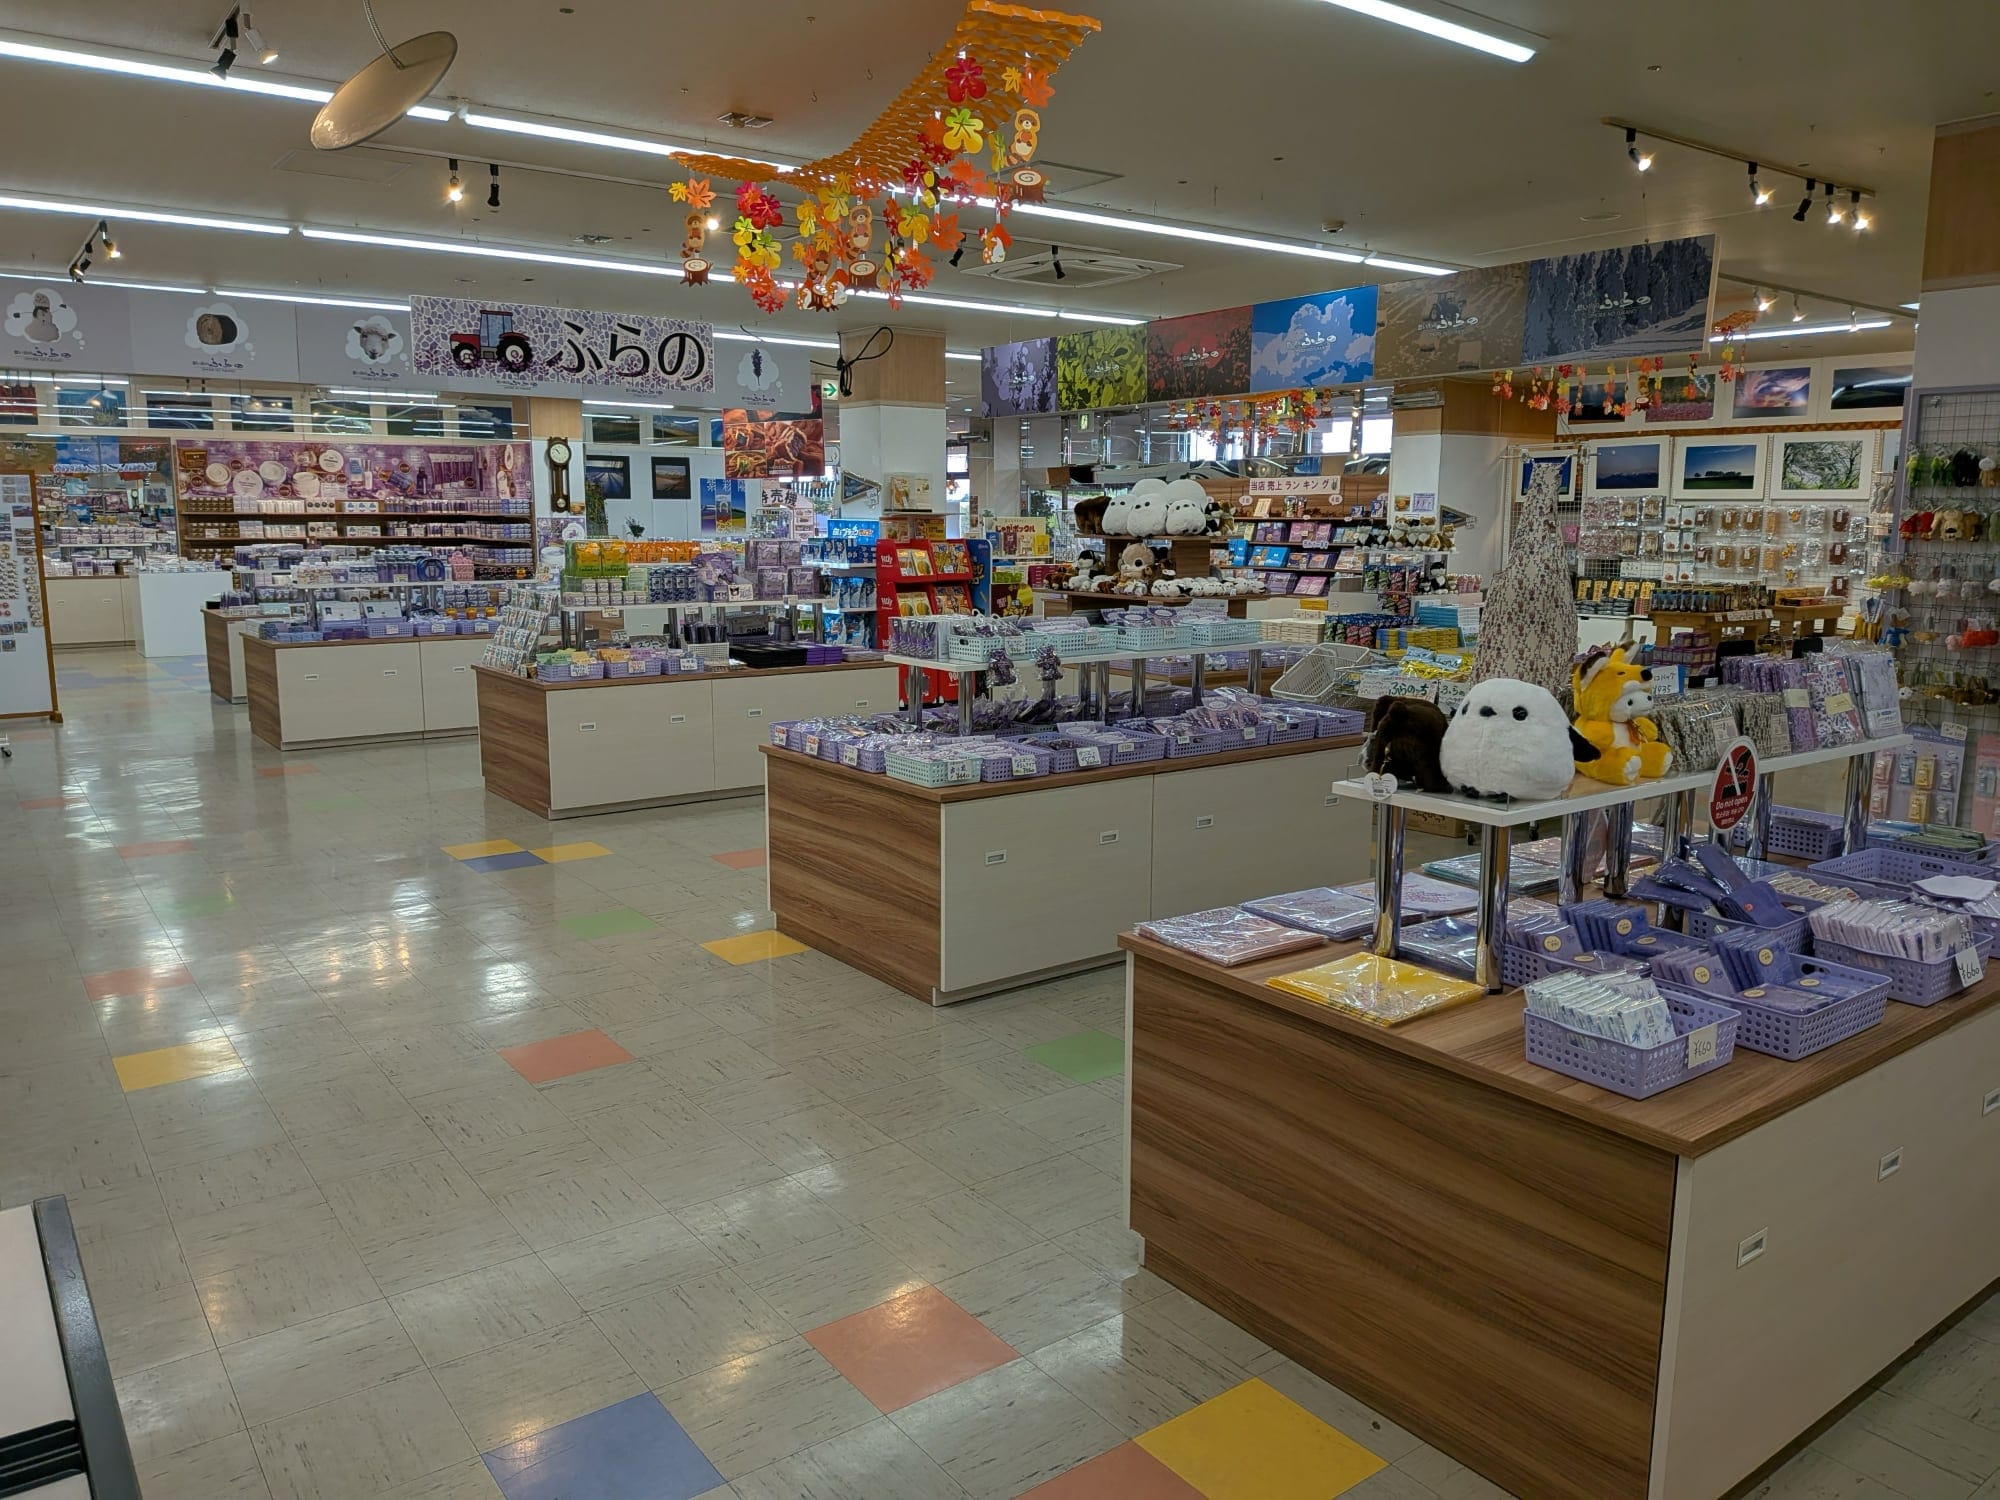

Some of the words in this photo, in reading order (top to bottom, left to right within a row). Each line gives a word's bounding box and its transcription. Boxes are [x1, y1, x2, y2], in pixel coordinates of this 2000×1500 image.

[546, 320, 707, 382] ふらの
[1715, 801, 1724, 810] Do
[1724, 799, 1733, 807] not
[1734, 796, 1749, 807] open
[1958, 960, 1980, 980] ¥660
